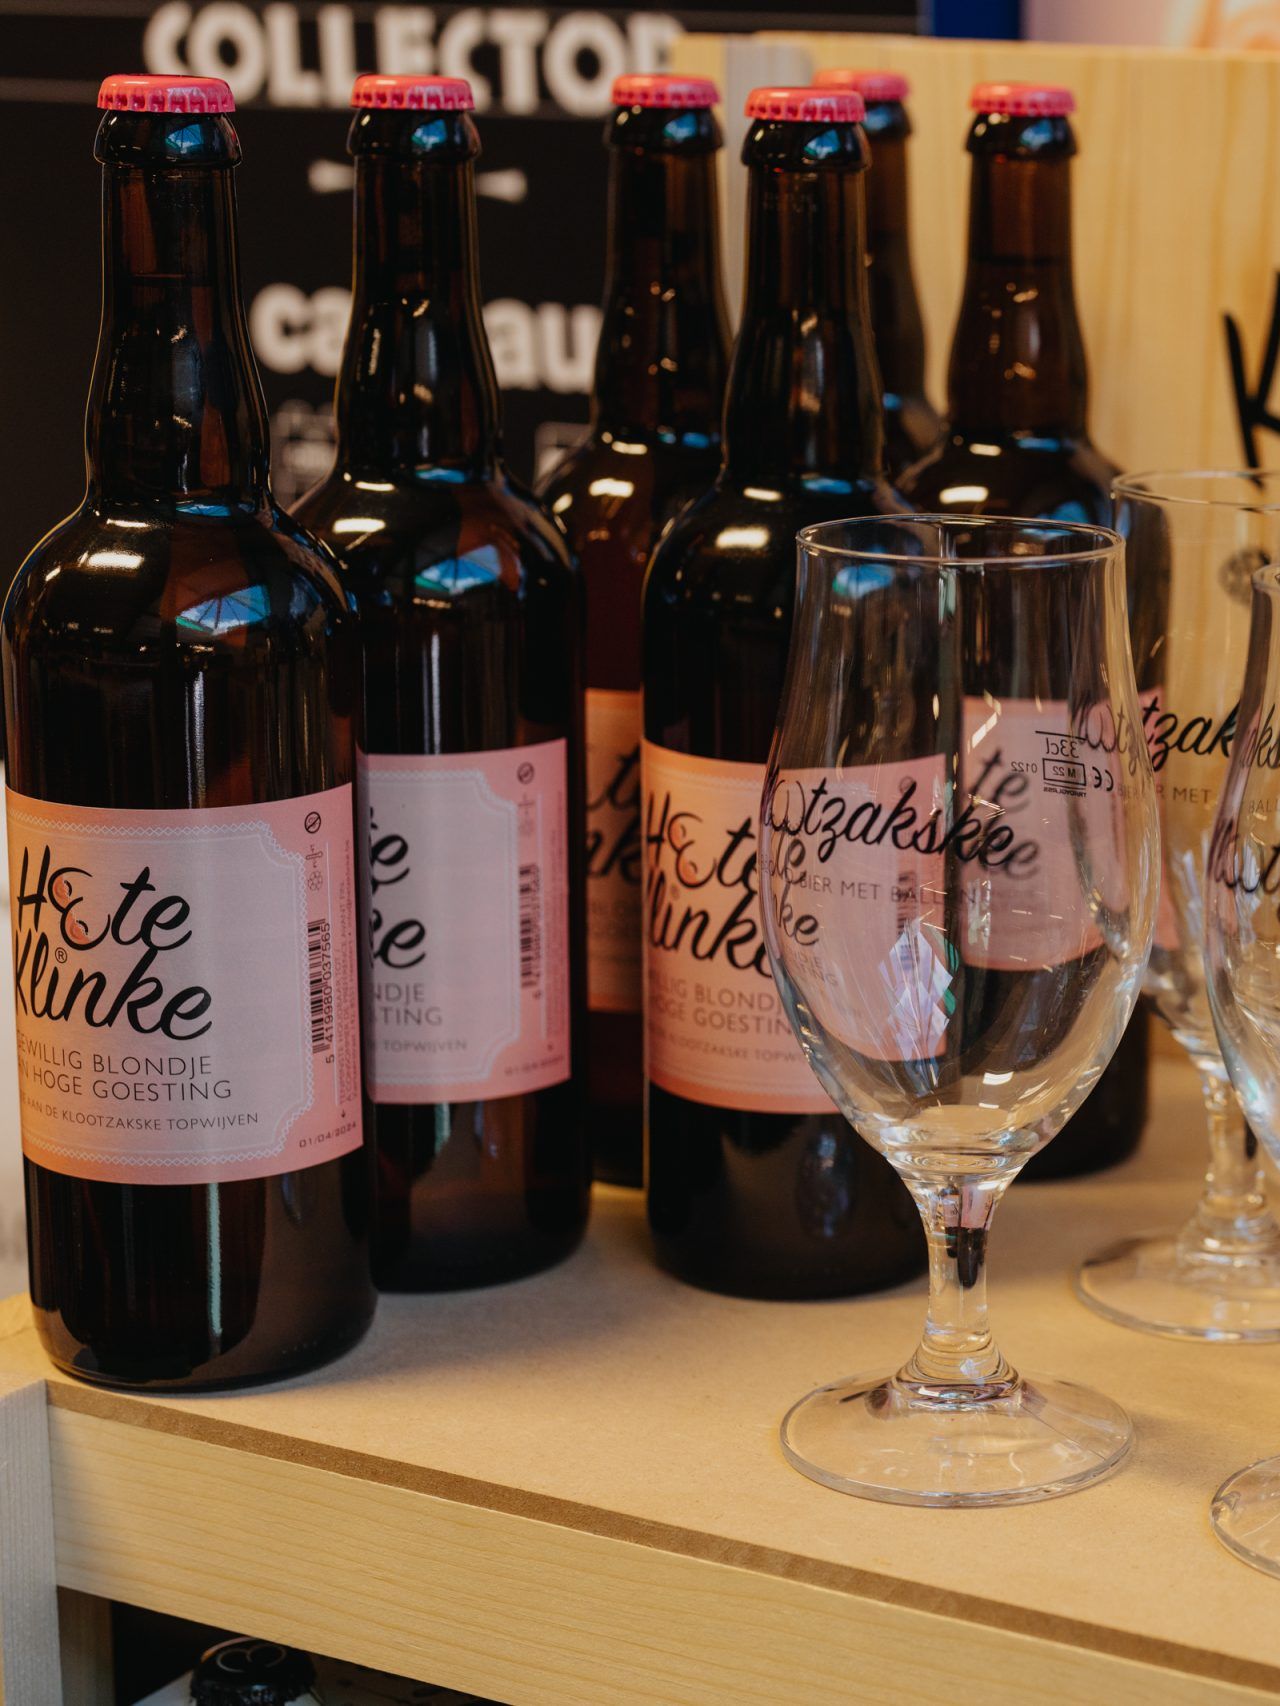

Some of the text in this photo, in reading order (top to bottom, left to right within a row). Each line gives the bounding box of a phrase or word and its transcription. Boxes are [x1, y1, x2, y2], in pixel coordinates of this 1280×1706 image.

[252, 283, 603, 393] caau
[841, 880, 881, 901] MET
[319, 922, 335, 1064] 5 419980 037565
[694, 1007, 792, 1036] GOESTIN
[92, 1053, 213, 1080] BLONDJE
[33, 1066, 83, 1096] HOGE
[92, 1080, 232, 1102] GOESTING
[45, 1104, 59, 1119] DE
[62, 1110, 162, 1131] KLOOTZAKSKE
[167, 1112, 259, 1130] TOPWIJVEN
